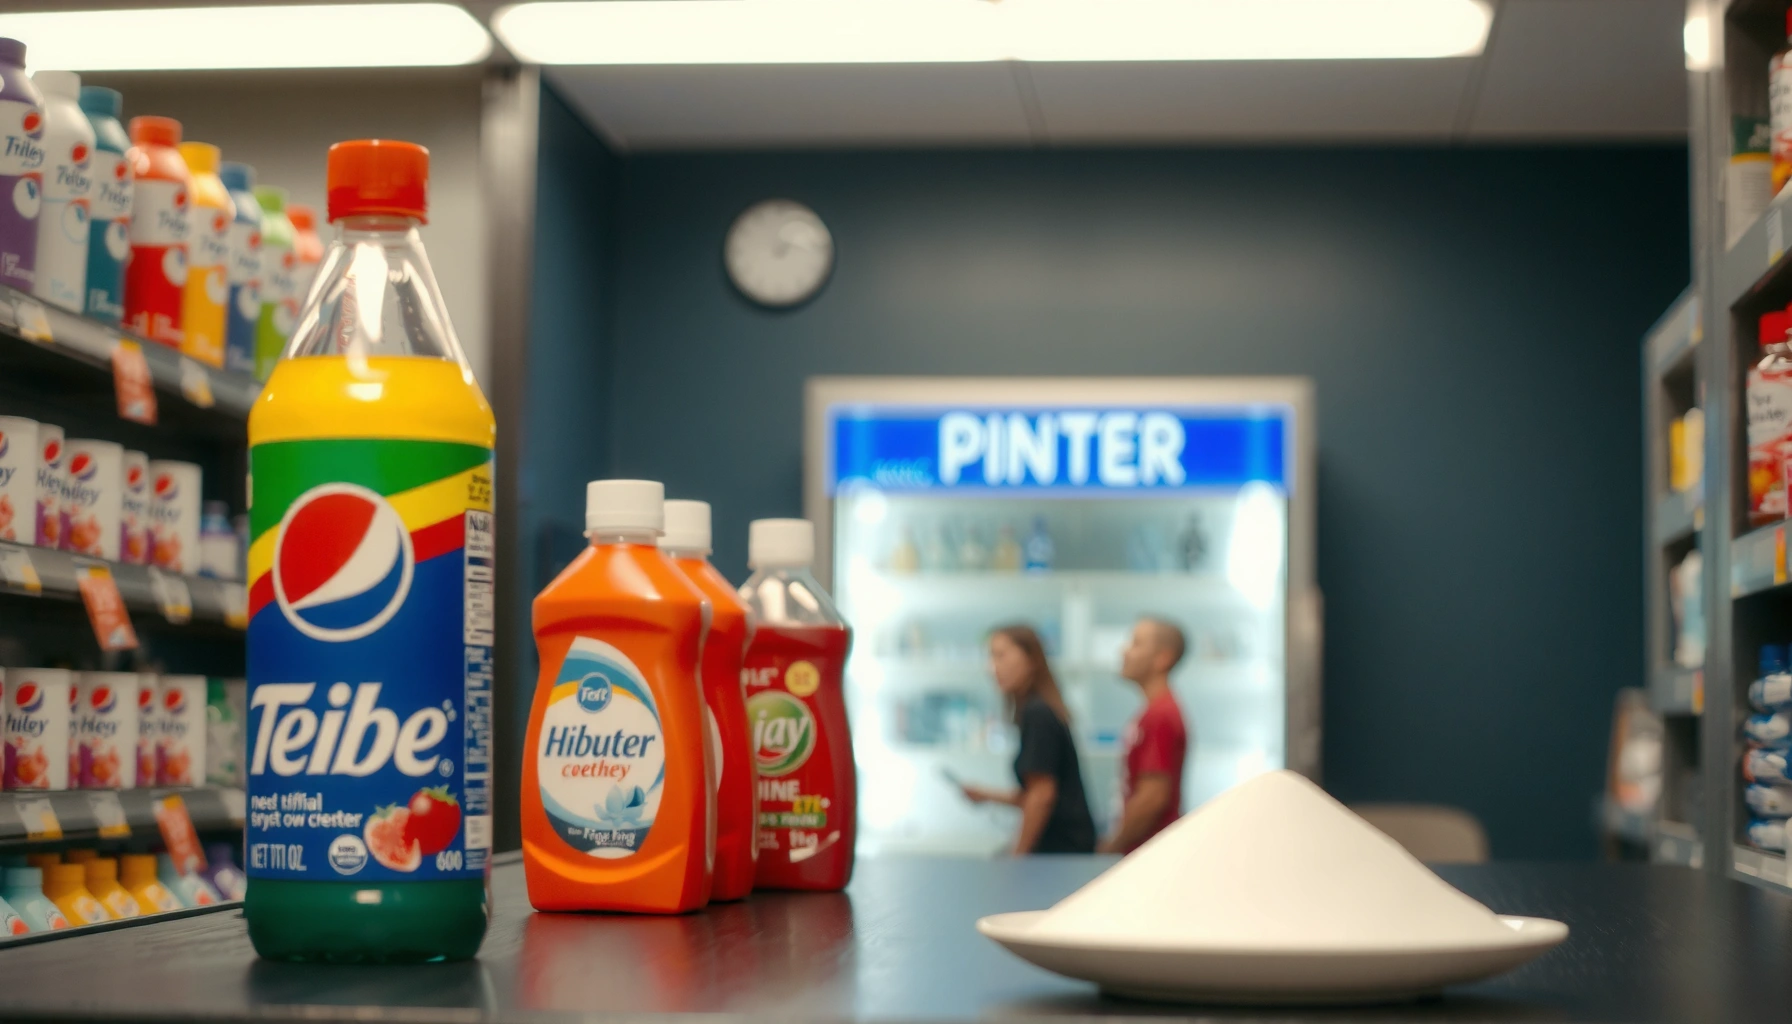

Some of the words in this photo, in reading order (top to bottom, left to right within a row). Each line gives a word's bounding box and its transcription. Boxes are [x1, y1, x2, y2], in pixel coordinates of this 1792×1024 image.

[938, 411, 1187, 487] PINTER
[250, 682, 448, 777] Teibe
[545, 725, 656, 758] Hibuter
